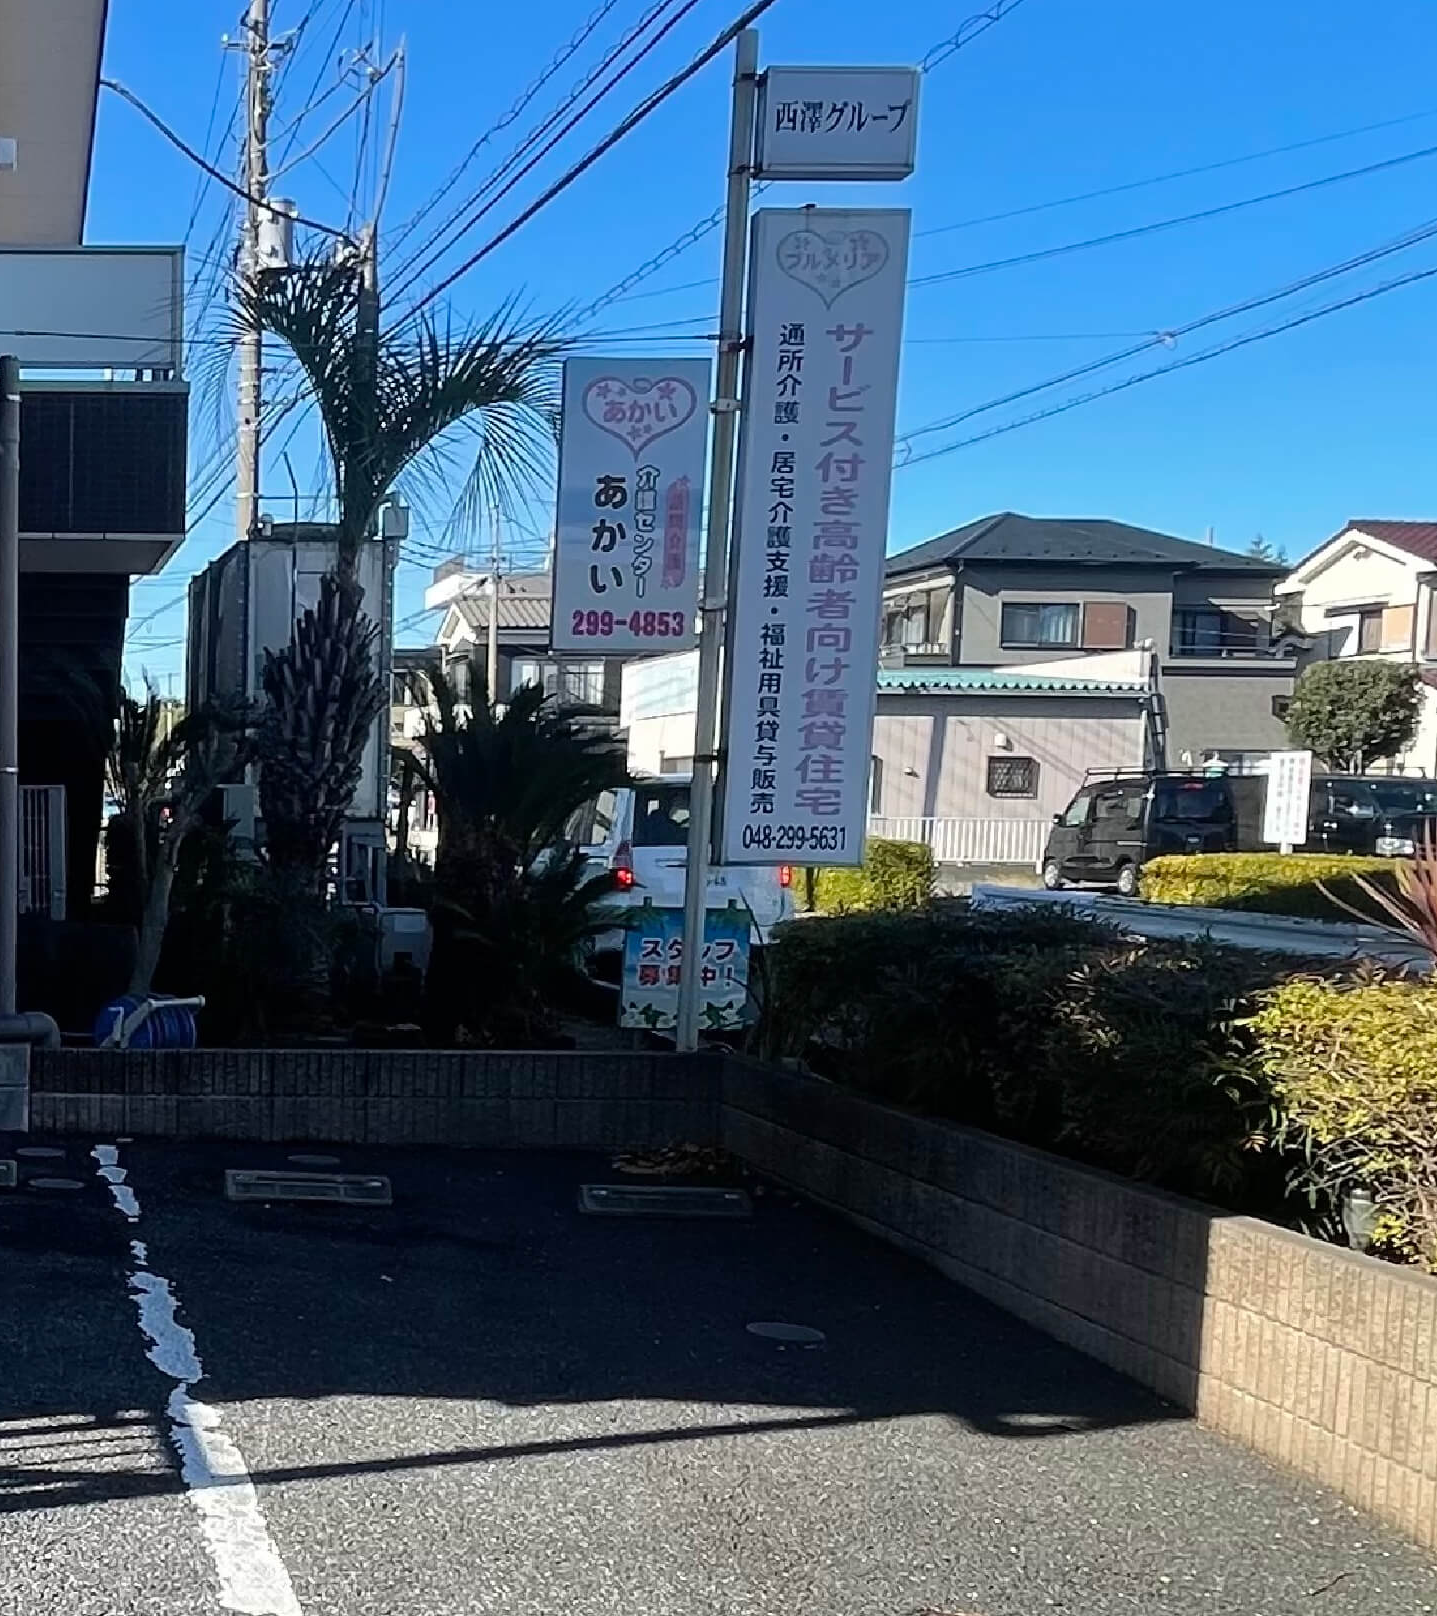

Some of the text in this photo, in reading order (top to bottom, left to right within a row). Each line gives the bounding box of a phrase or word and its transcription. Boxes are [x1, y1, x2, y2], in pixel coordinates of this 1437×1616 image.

[775, 99, 913, 134] 西澤グループ
[603, 399, 679, 424] あかい
[591, 474, 628, 594] あかい
[793, 322, 875, 816] サービス付き高齢者向け賃貸住宅
[571, 609, 685, 637] 299-4853
[742, 823, 847, 851] 048-299-5631
